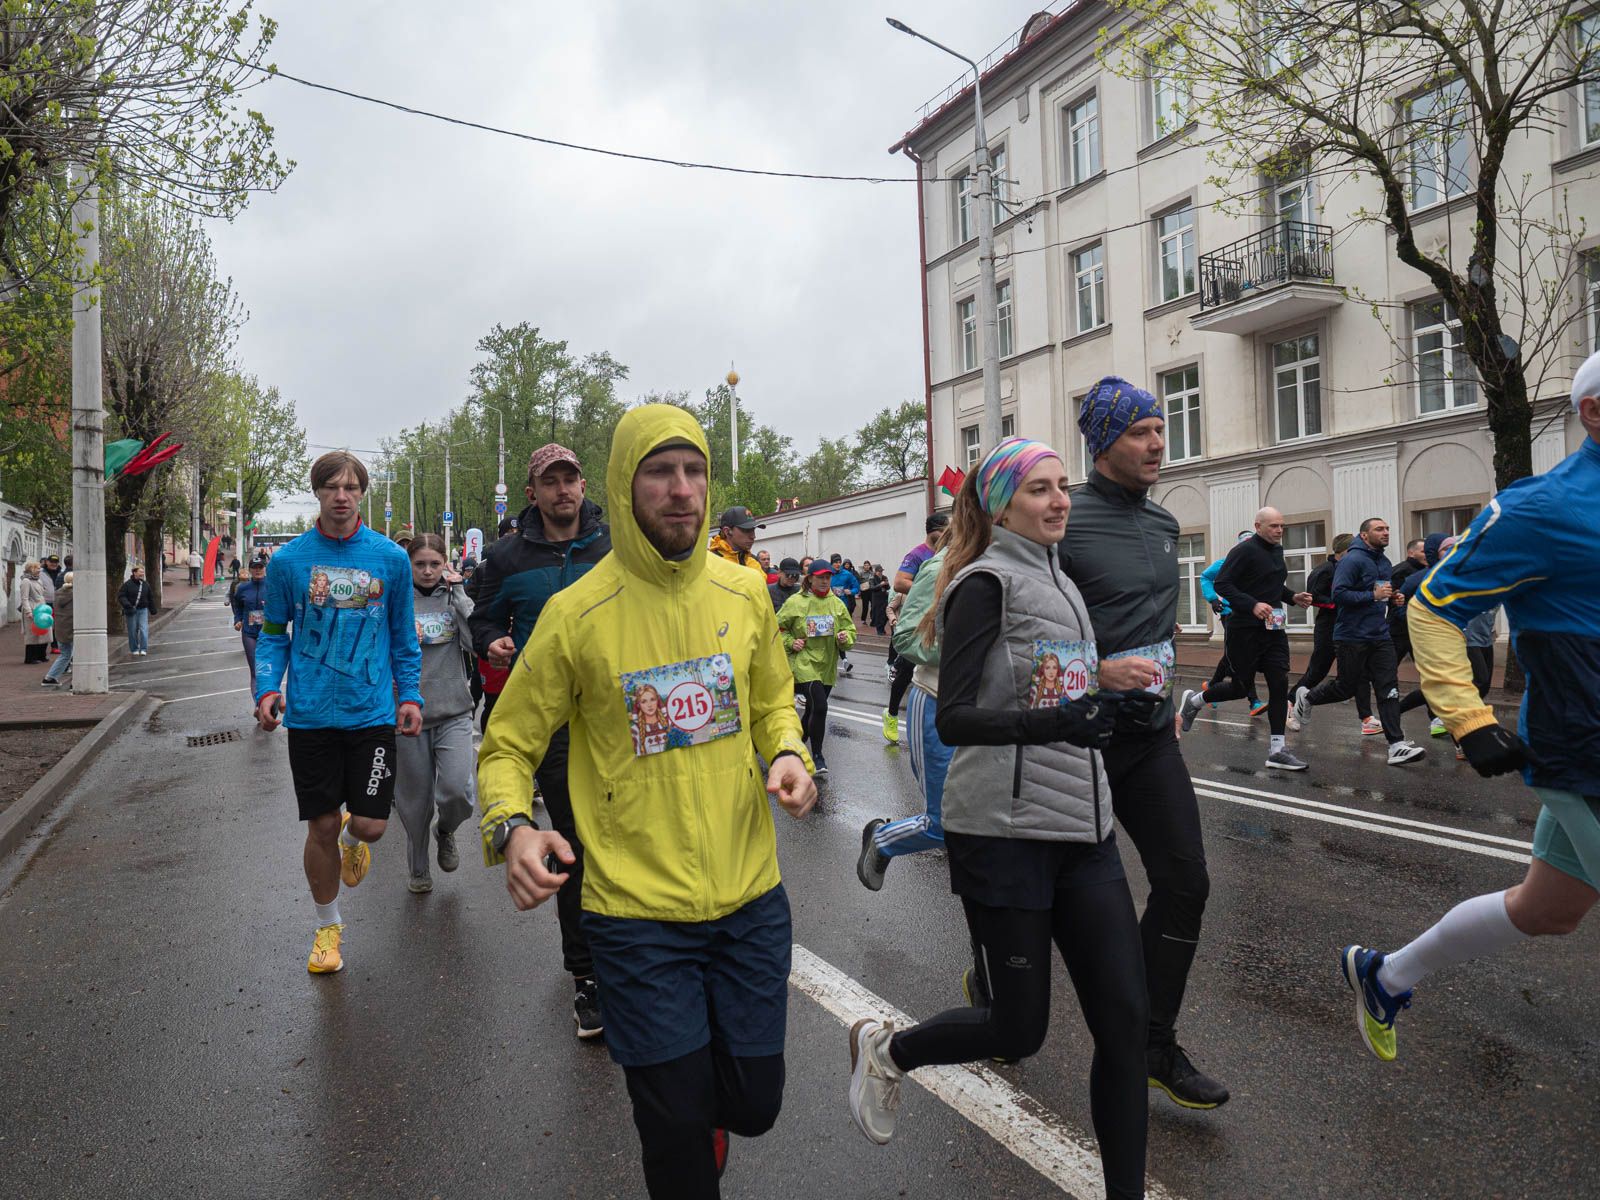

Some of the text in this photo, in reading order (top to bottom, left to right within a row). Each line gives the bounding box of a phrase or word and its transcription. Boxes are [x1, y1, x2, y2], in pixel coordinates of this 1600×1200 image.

[331, 584, 352, 595] 480
[426, 624, 441, 633] 479
[1067, 671, 1086, 690] 216
[672, 692, 708, 720] 215
[366, 747, 386, 796] adidas
